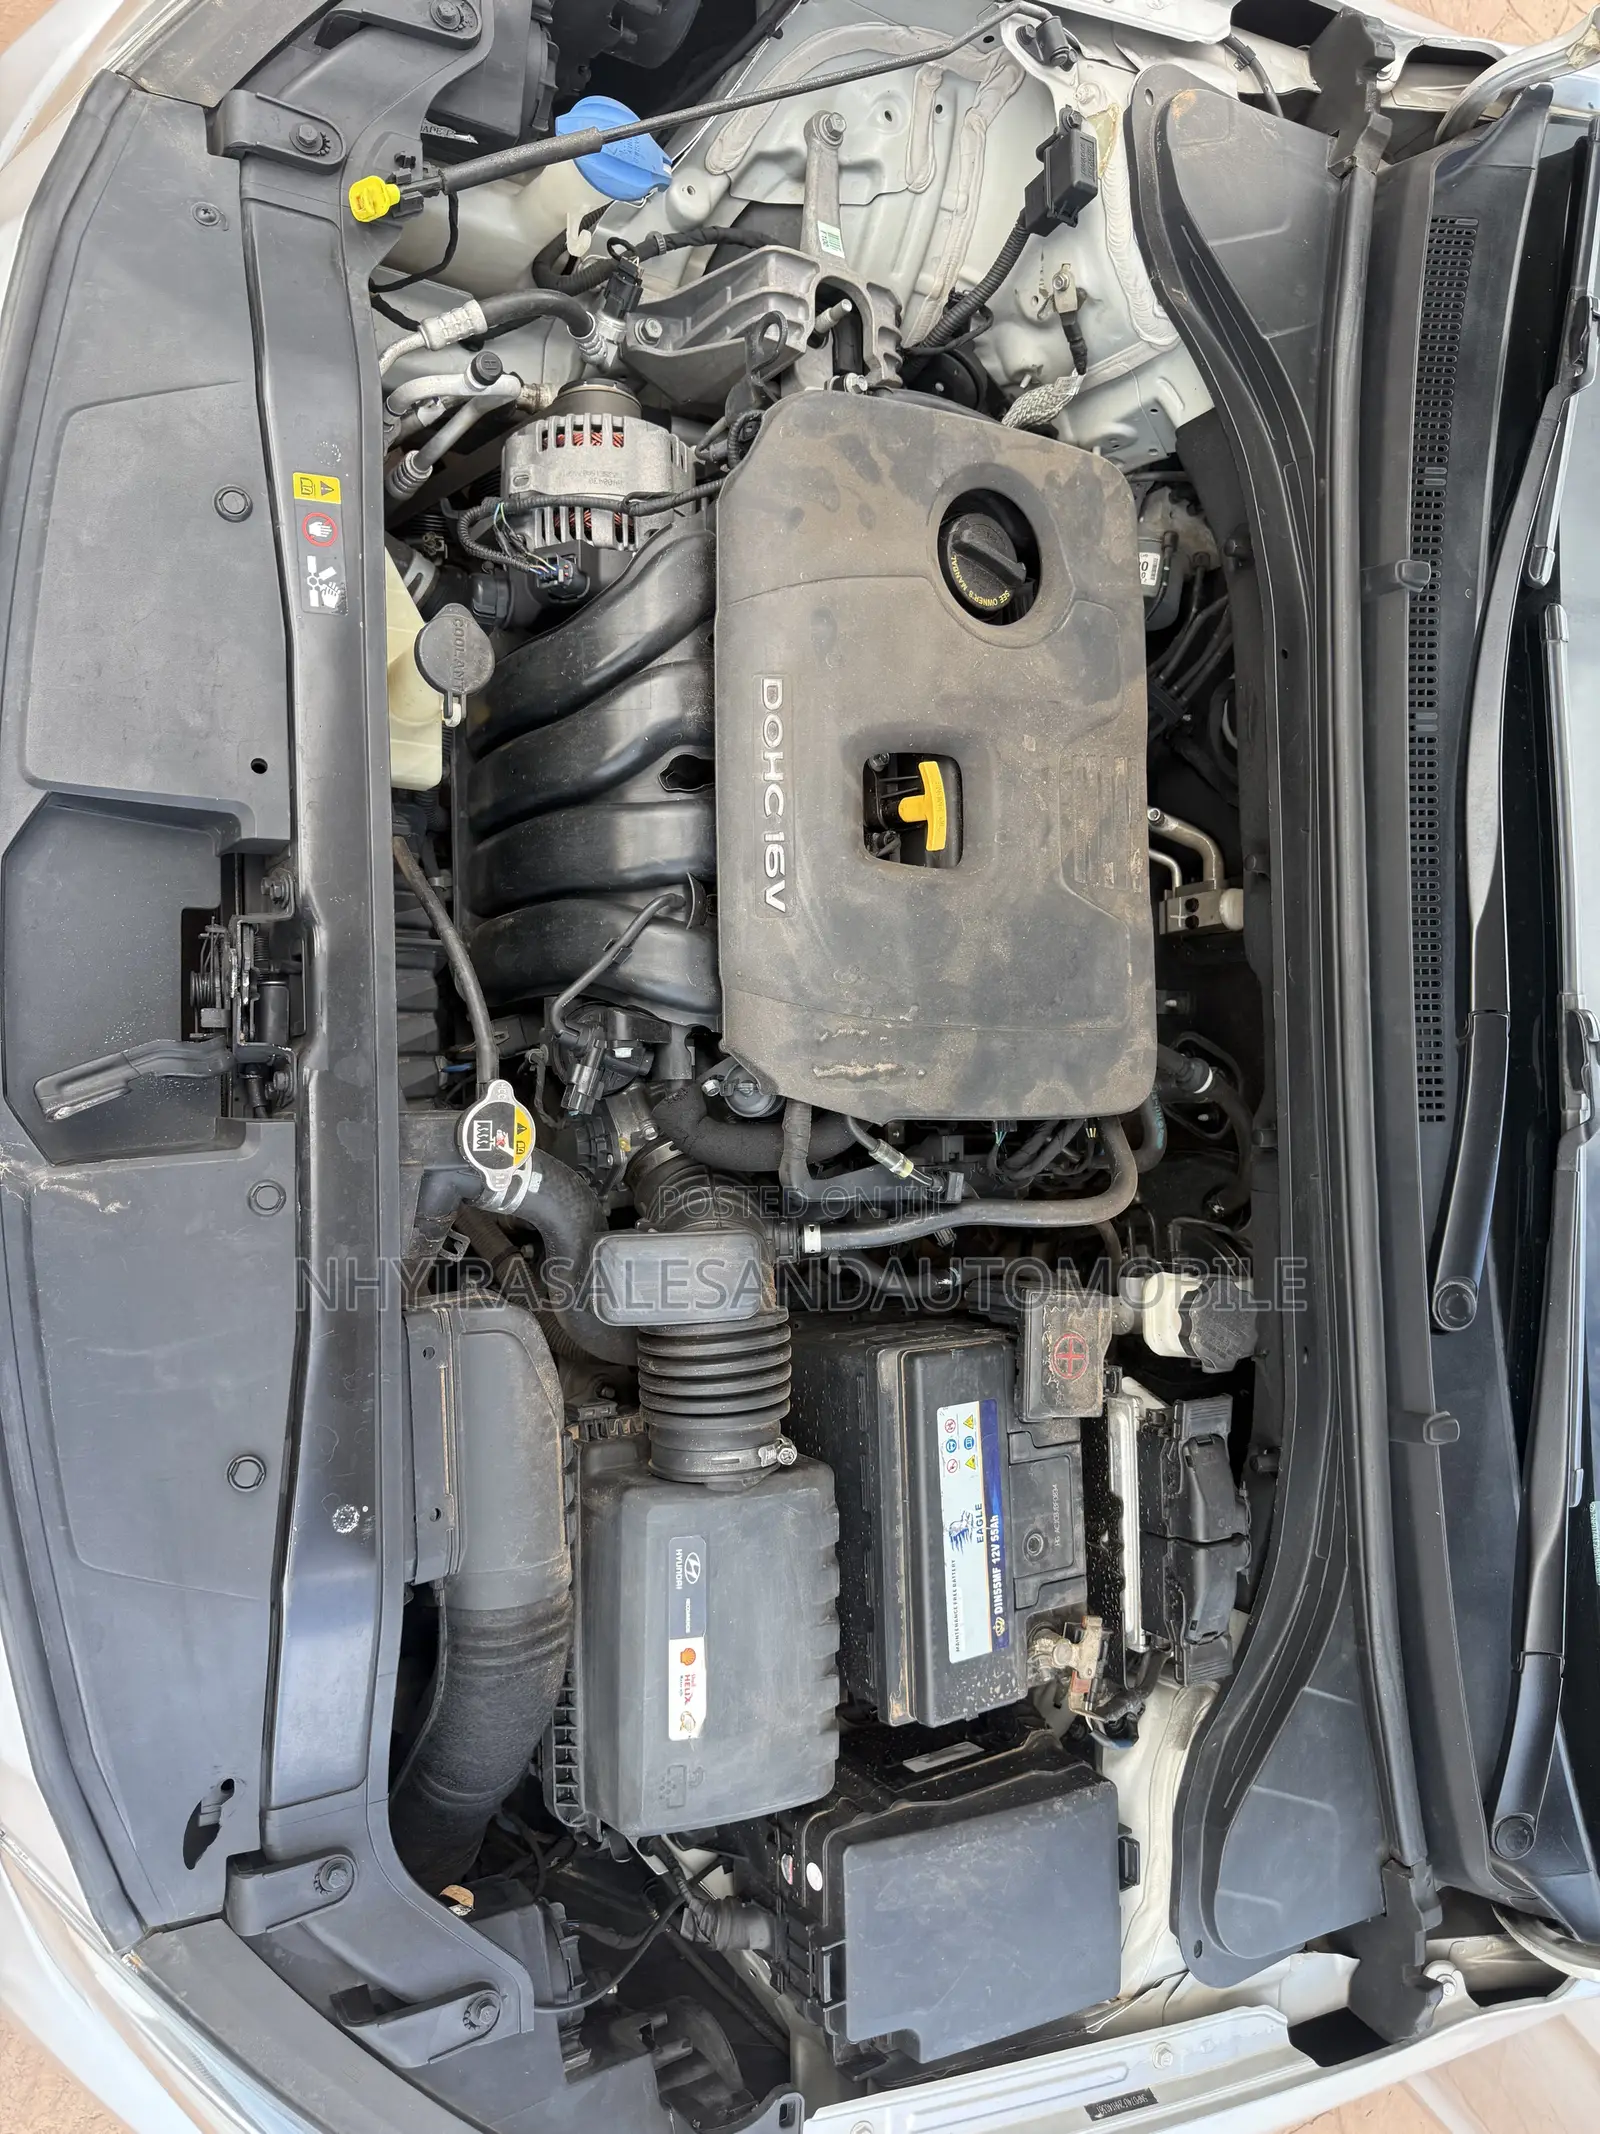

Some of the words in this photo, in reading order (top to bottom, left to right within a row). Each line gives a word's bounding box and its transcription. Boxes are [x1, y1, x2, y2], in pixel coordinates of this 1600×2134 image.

[452, 618, 465, 692] COOLANT
[762, 678, 785, 818] DOHC
[764, 831, 786, 913] 16V
[975, 1504, 985, 1544] EAGLE
[990, 1515, 1000, 1540] 55Ah
[675, 1549, 683, 1590] HYUNDAI
[991, 1541, 1002, 1565] 12V
[993, 1567, 1004, 1615] DIN55MF
[952, 1605, 960, 1653] MAINTENANCE
[684, 1673, 692, 1706] HELIX
